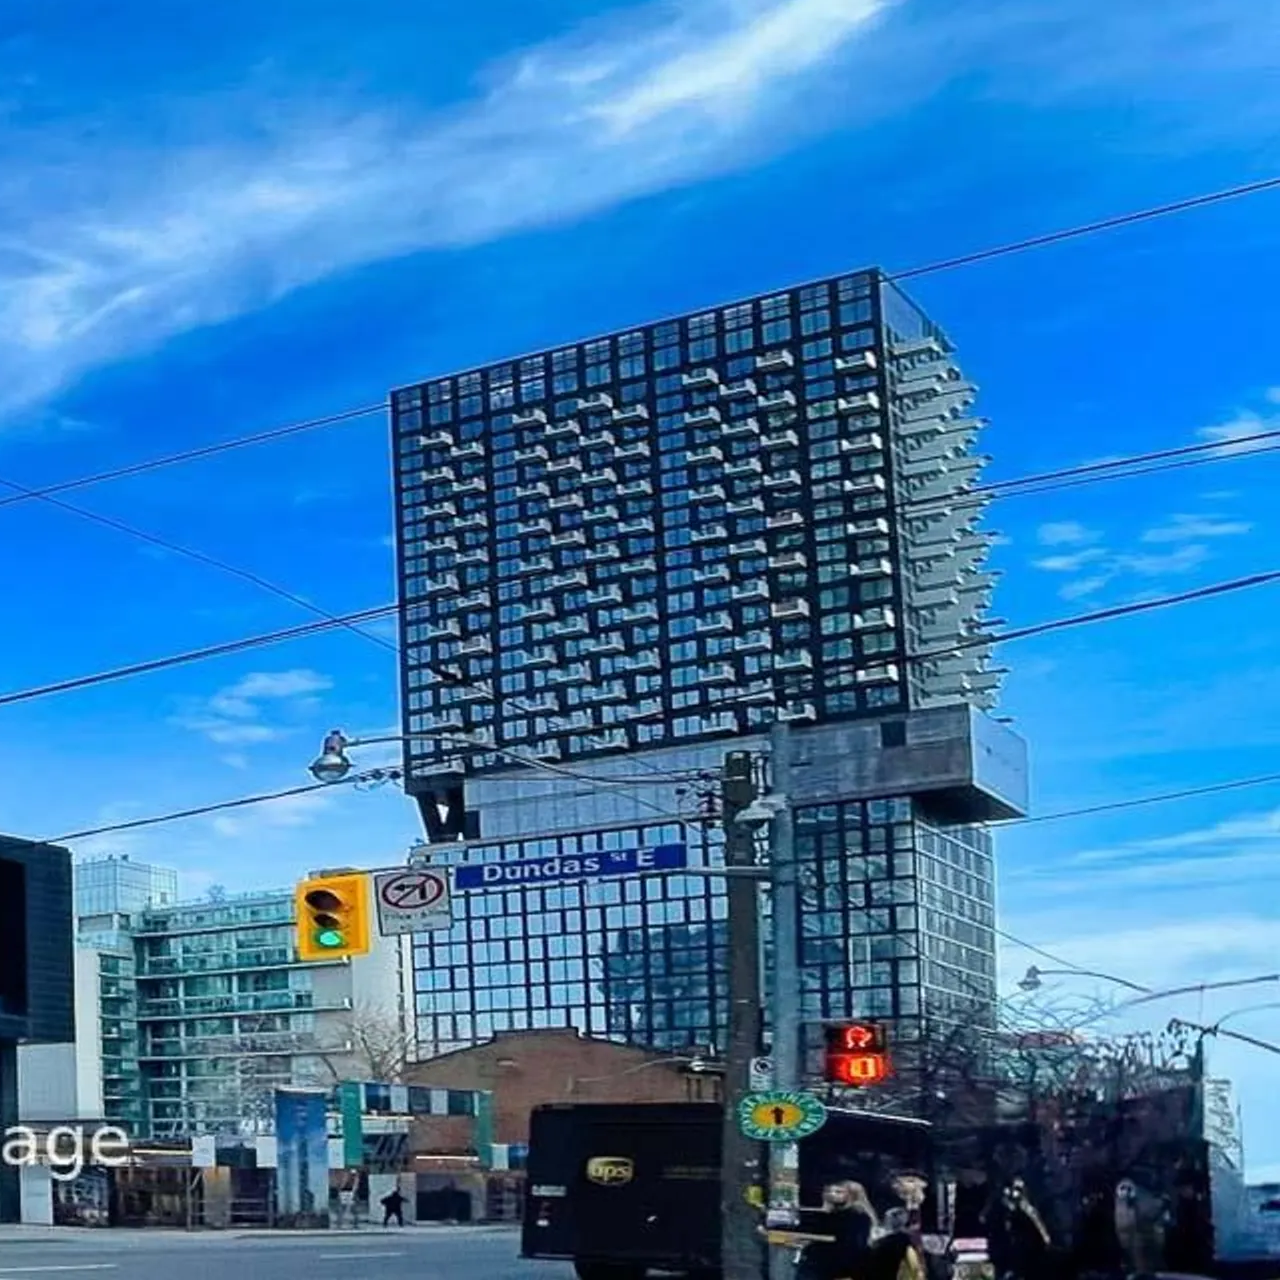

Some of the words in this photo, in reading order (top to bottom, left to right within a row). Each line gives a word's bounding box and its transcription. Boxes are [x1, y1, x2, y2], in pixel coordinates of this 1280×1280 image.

[482, 856, 601, 882] Dundas
[610, 851, 628, 862] St
[636, 848, 656, 867] E
[592, 1166, 631, 1182] ups
